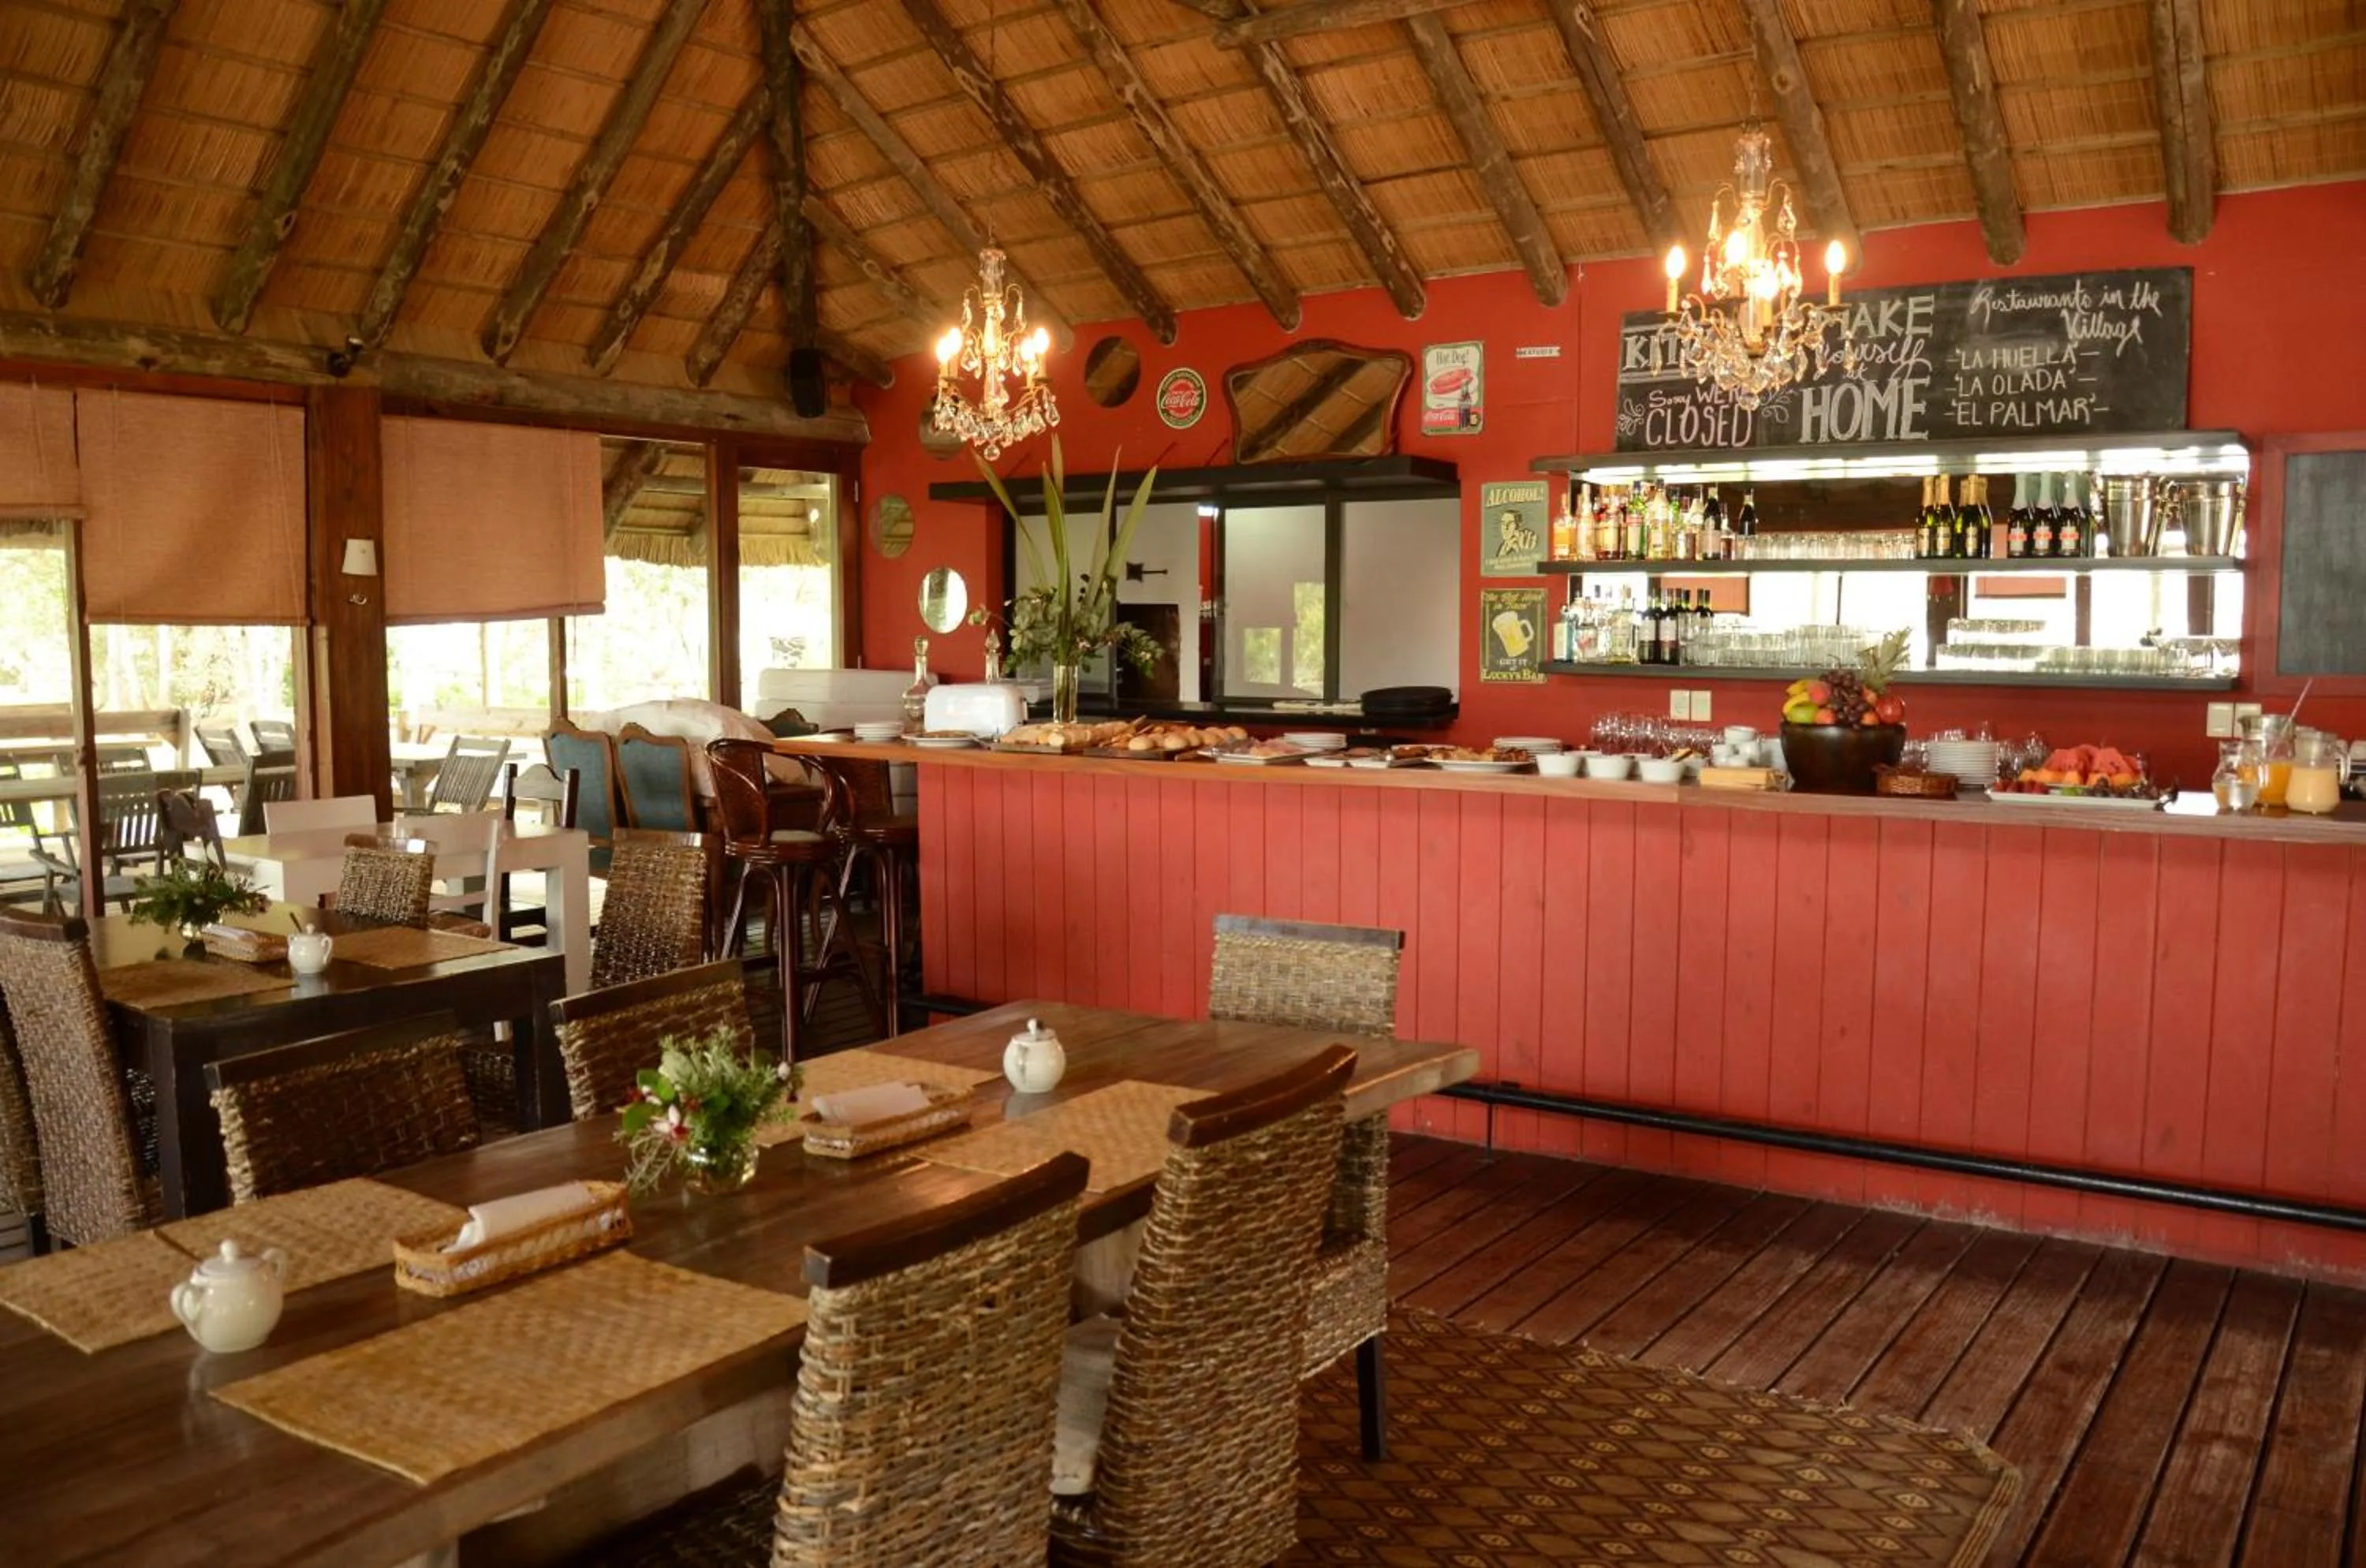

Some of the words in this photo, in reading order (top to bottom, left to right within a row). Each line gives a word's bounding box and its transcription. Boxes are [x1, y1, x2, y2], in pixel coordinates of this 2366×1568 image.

[1814, 294, 1935, 340] MAKE
[1970, 279, 2092, 333] Restaurants
[2099, 285, 2124, 309] in
[2129, 281, 2163, 317] the
[2060, 308, 2143, 358] Village
[1645, 405, 1752, 448] CLOSED
[1798, 375, 1931, 444] HOME
[1484, 487, 1544, 507] ALCOHOL!
